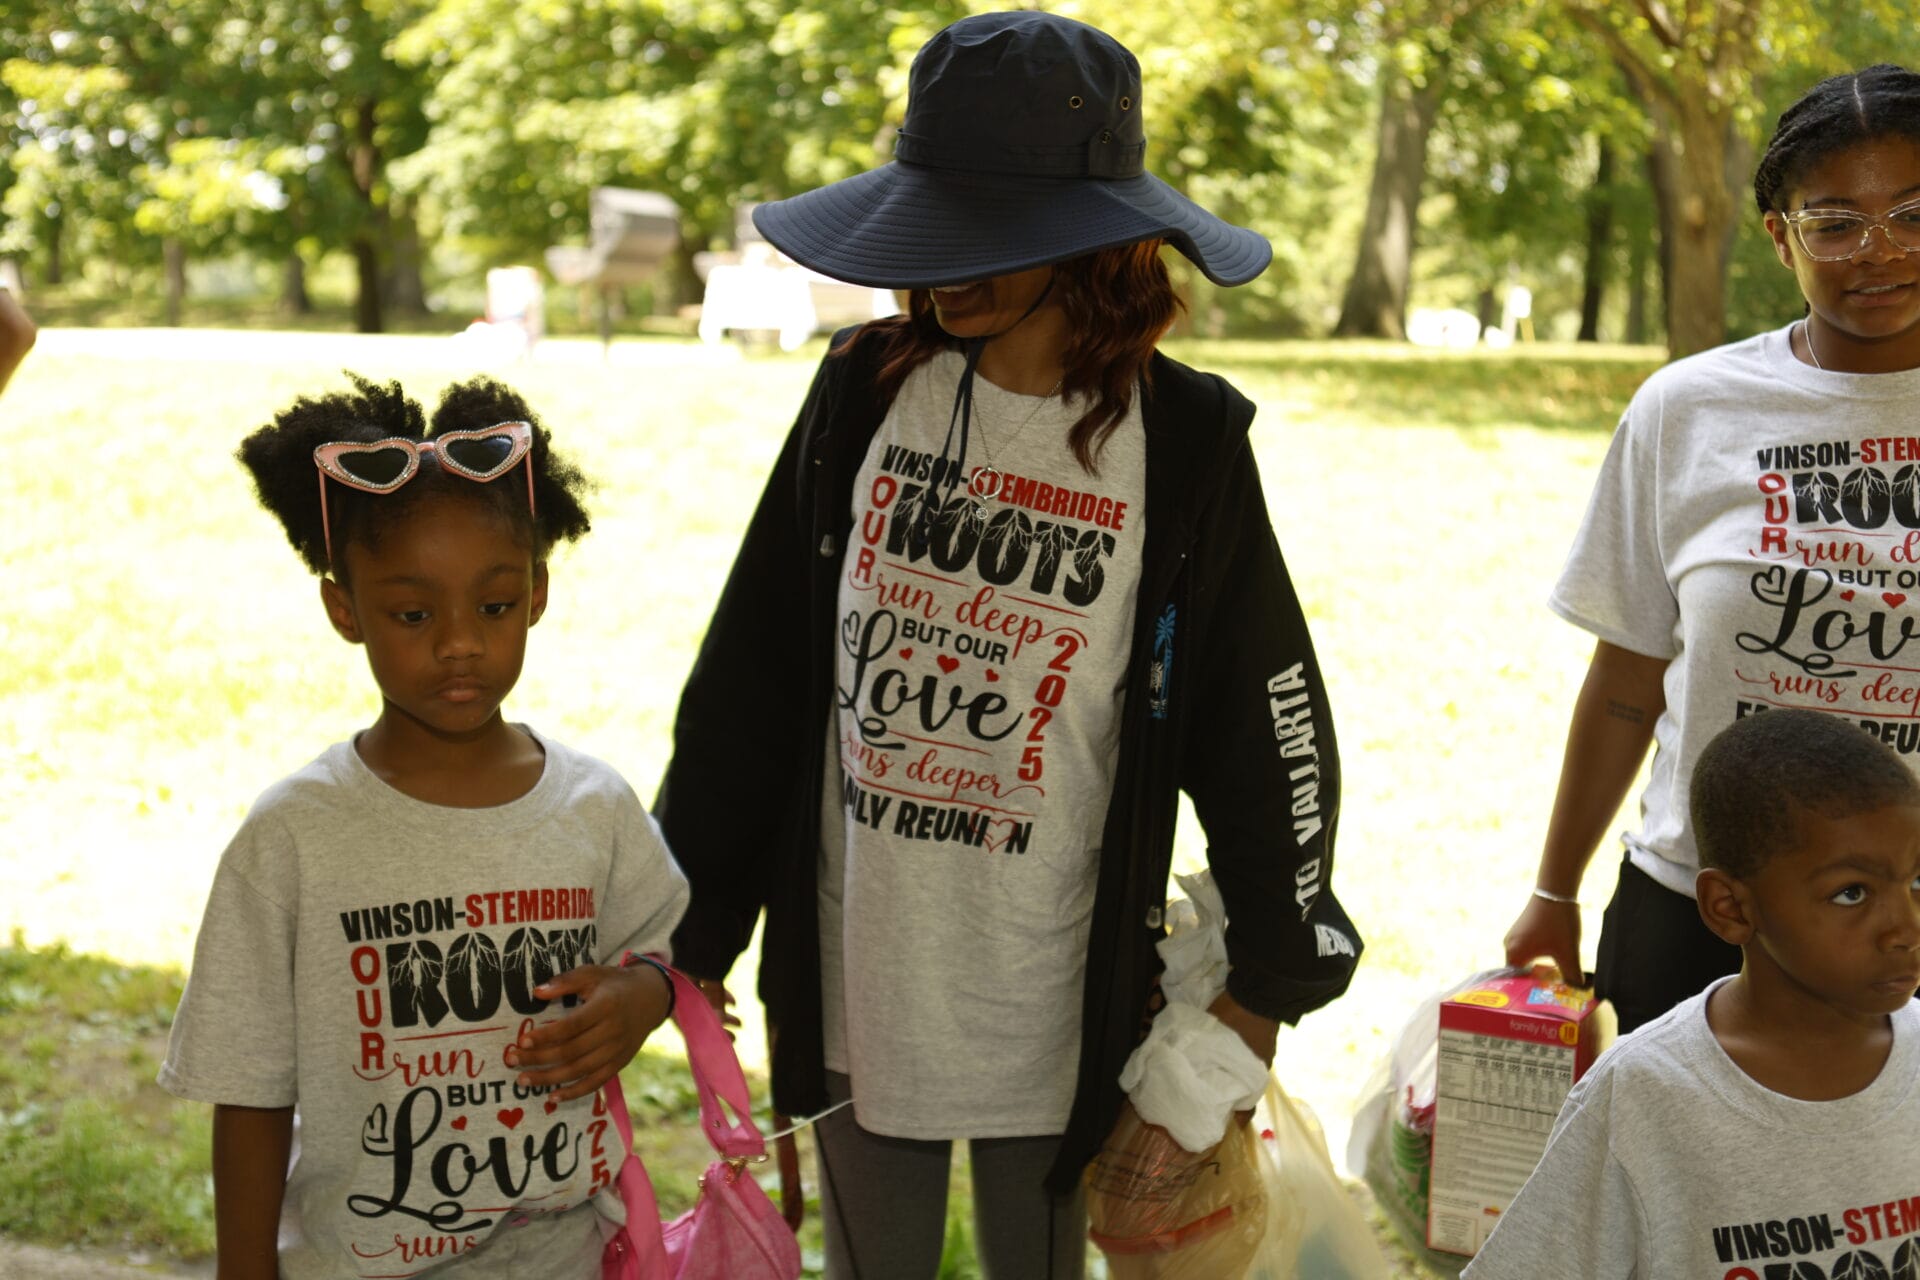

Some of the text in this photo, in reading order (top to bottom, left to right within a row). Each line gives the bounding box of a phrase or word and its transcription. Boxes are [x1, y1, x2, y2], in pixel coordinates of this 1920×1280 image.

[854, 475, 897, 584] OUR
[886, 482, 1116, 607] ROOTS
[1757, 472, 1789, 554] OUR
[1789, 538, 1874, 566] run
[868, 573, 1060, 659] run deep
[1838, 569, 1892, 589] BUT
[838, 610, 1024, 750] Love
[901, 618, 1009, 665] BUT OUR
[1017, 635, 1079, 783] 2025
[1764, 671, 1847, 703] runs
[906, 749, 1008, 801] deeper
[1267, 662, 1322, 847] VALLARTA
[350, 946, 386, 1072] OUR
[386, 1048, 484, 1087] run
[446, 1079, 506, 1109] BUT
[346, 1086, 582, 1233] Love
